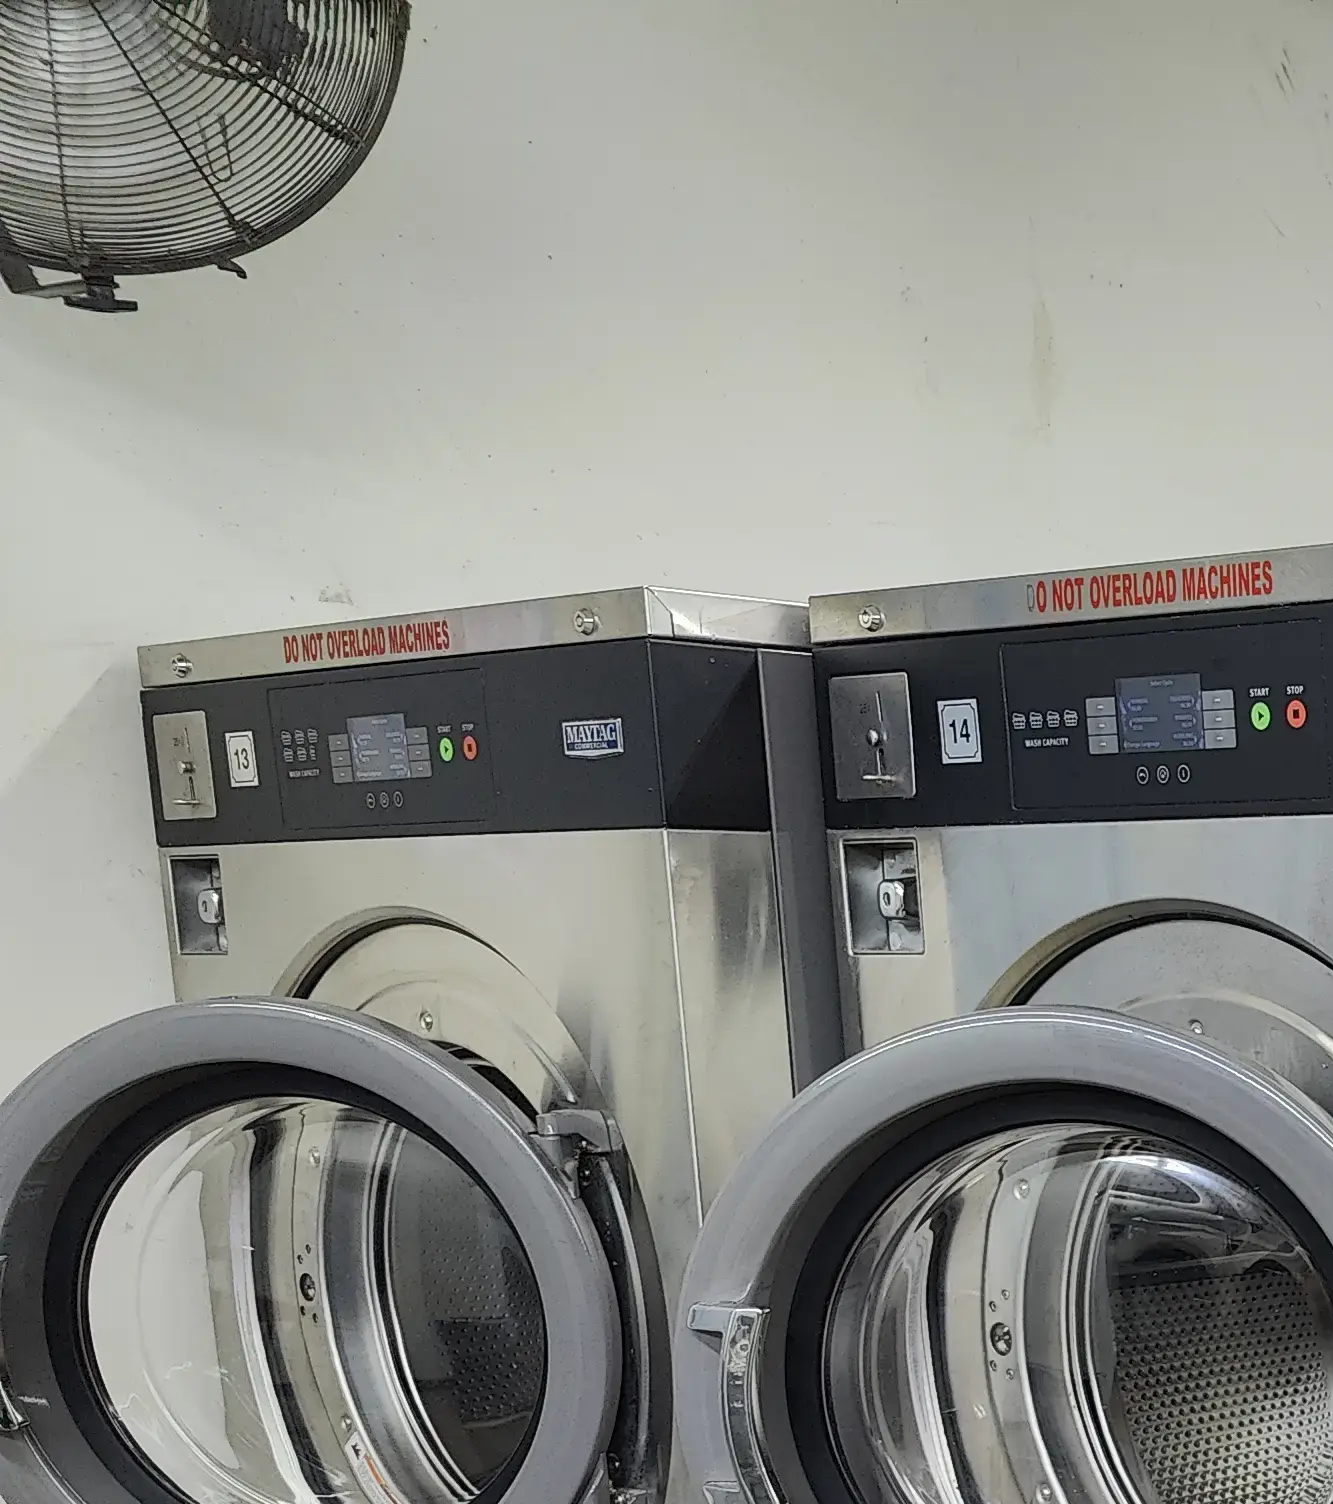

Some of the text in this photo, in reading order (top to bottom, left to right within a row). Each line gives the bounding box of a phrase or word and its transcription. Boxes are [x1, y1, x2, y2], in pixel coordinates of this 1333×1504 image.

[1052, 578, 1084, 612] NOT
[1089, 569, 1177, 609] OVERLOAD
[1182, 560, 1272, 601] MACHINES
[282, 620, 450, 664] DO NOT OVERLOAD MACHINES
[1249, 687, 1270, 697] START
[1286, 686, 1304, 695] STOP
[566, 724, 616, 743] MAYTAG
[949, 718, 971, 744] 14
[575, 742, 608, 750] COMMERCIAL
[1024, 737, 1069, 748] WASH CAPACITY
[234, 748, 249, 770] 13
